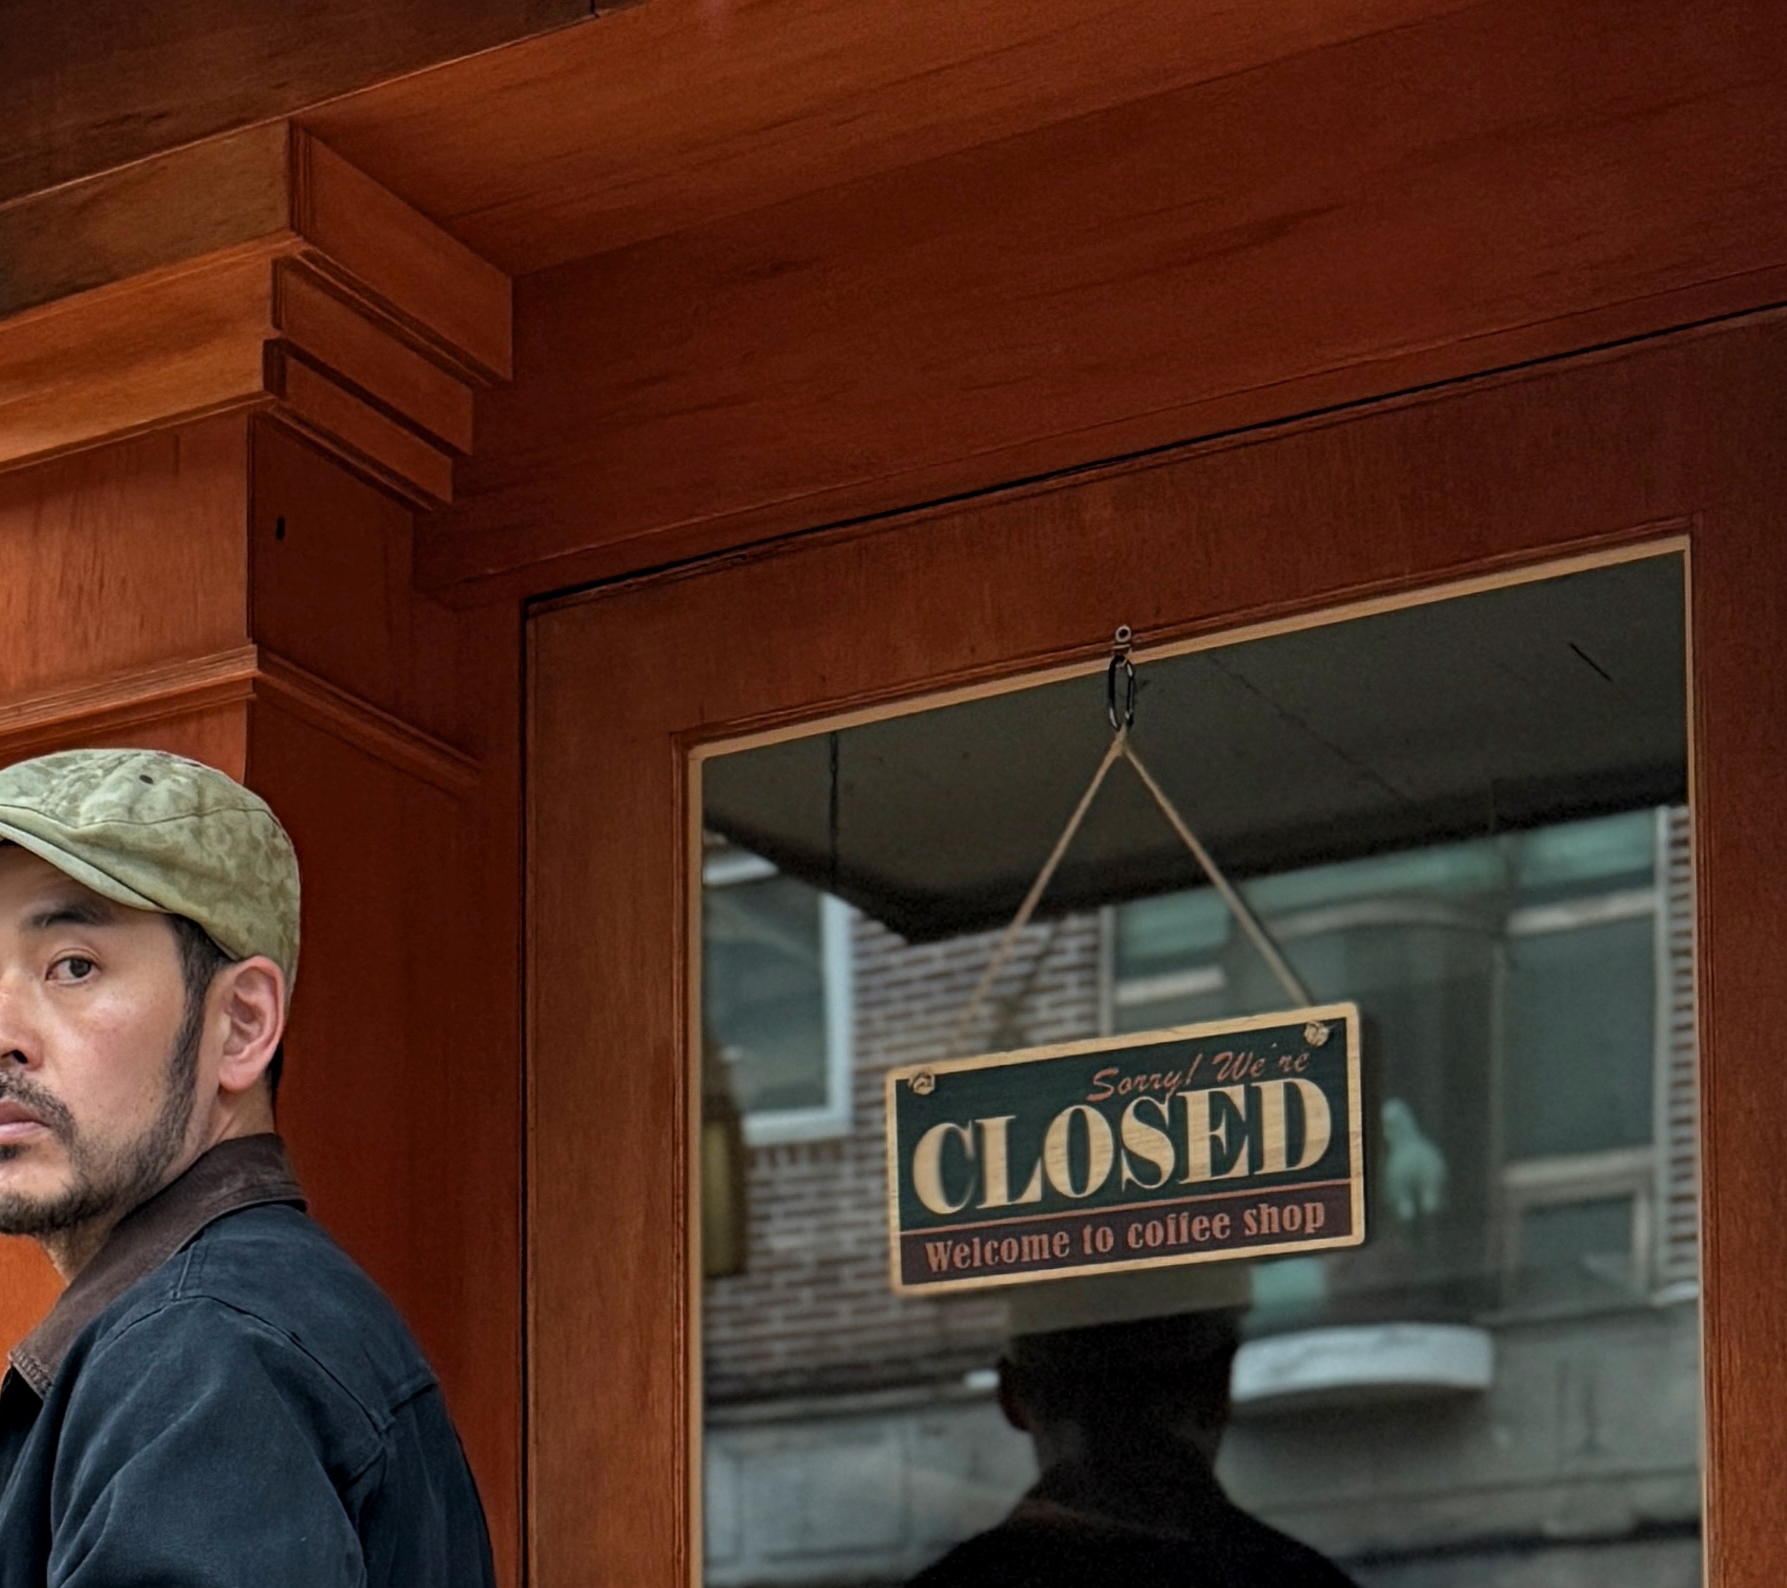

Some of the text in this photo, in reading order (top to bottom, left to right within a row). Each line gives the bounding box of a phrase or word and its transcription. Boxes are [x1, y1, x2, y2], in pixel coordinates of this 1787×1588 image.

[1086, 1043, 1311, 1102] Sorry! We're
[913, 1078, 1331, 1214] CLOSED
[925, 1202, 1326, 1273] Welcome to coffee shop
